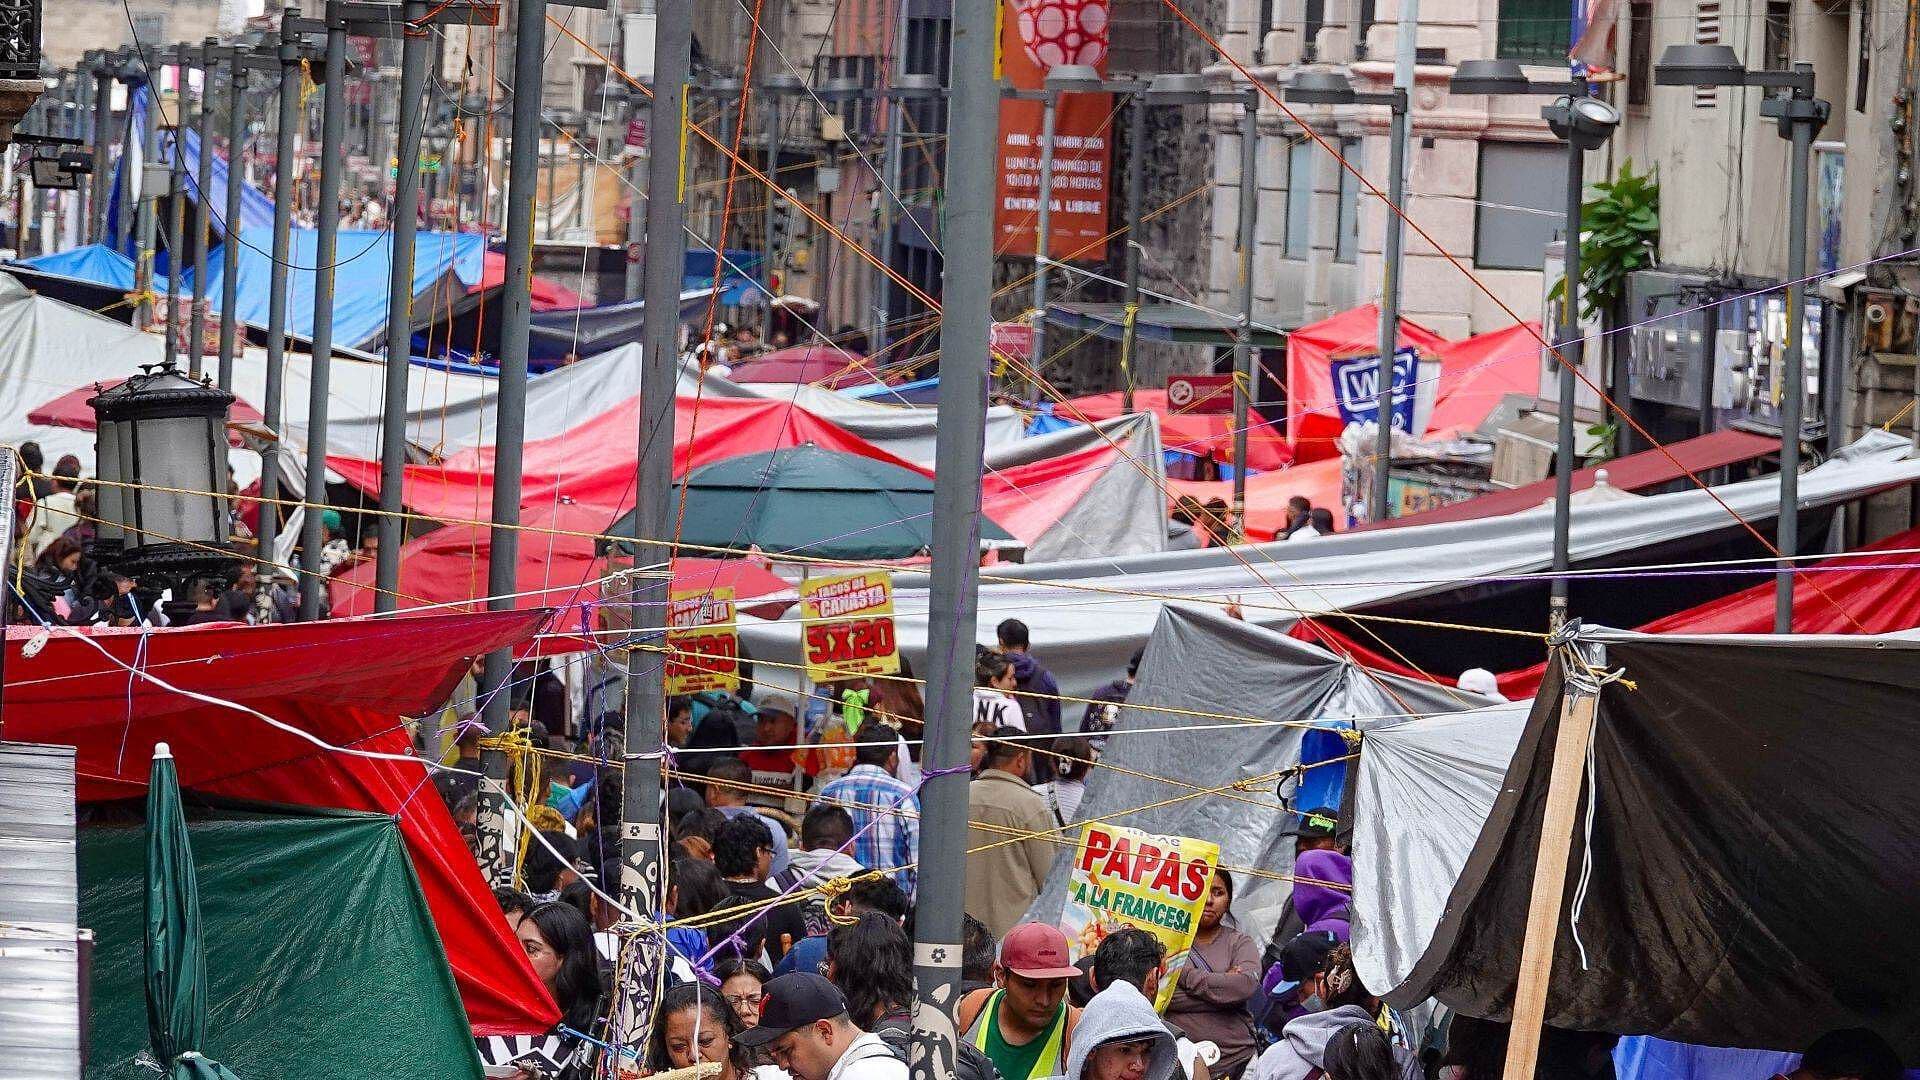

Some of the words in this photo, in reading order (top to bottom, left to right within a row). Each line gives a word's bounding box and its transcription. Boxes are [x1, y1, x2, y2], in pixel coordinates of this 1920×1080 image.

[1066, 200, 1101, 215] LIBRE
[817, 581, 851, 598] TACOS
[819, 585, 886, 618] CANASTA
[1081, 829, 1209, 901] PAPAS
[1074, 883, 1087, 904] A
[1090, 886, 1110, 910] LA
[1112, 891, 1192, 934] FRANCESA
